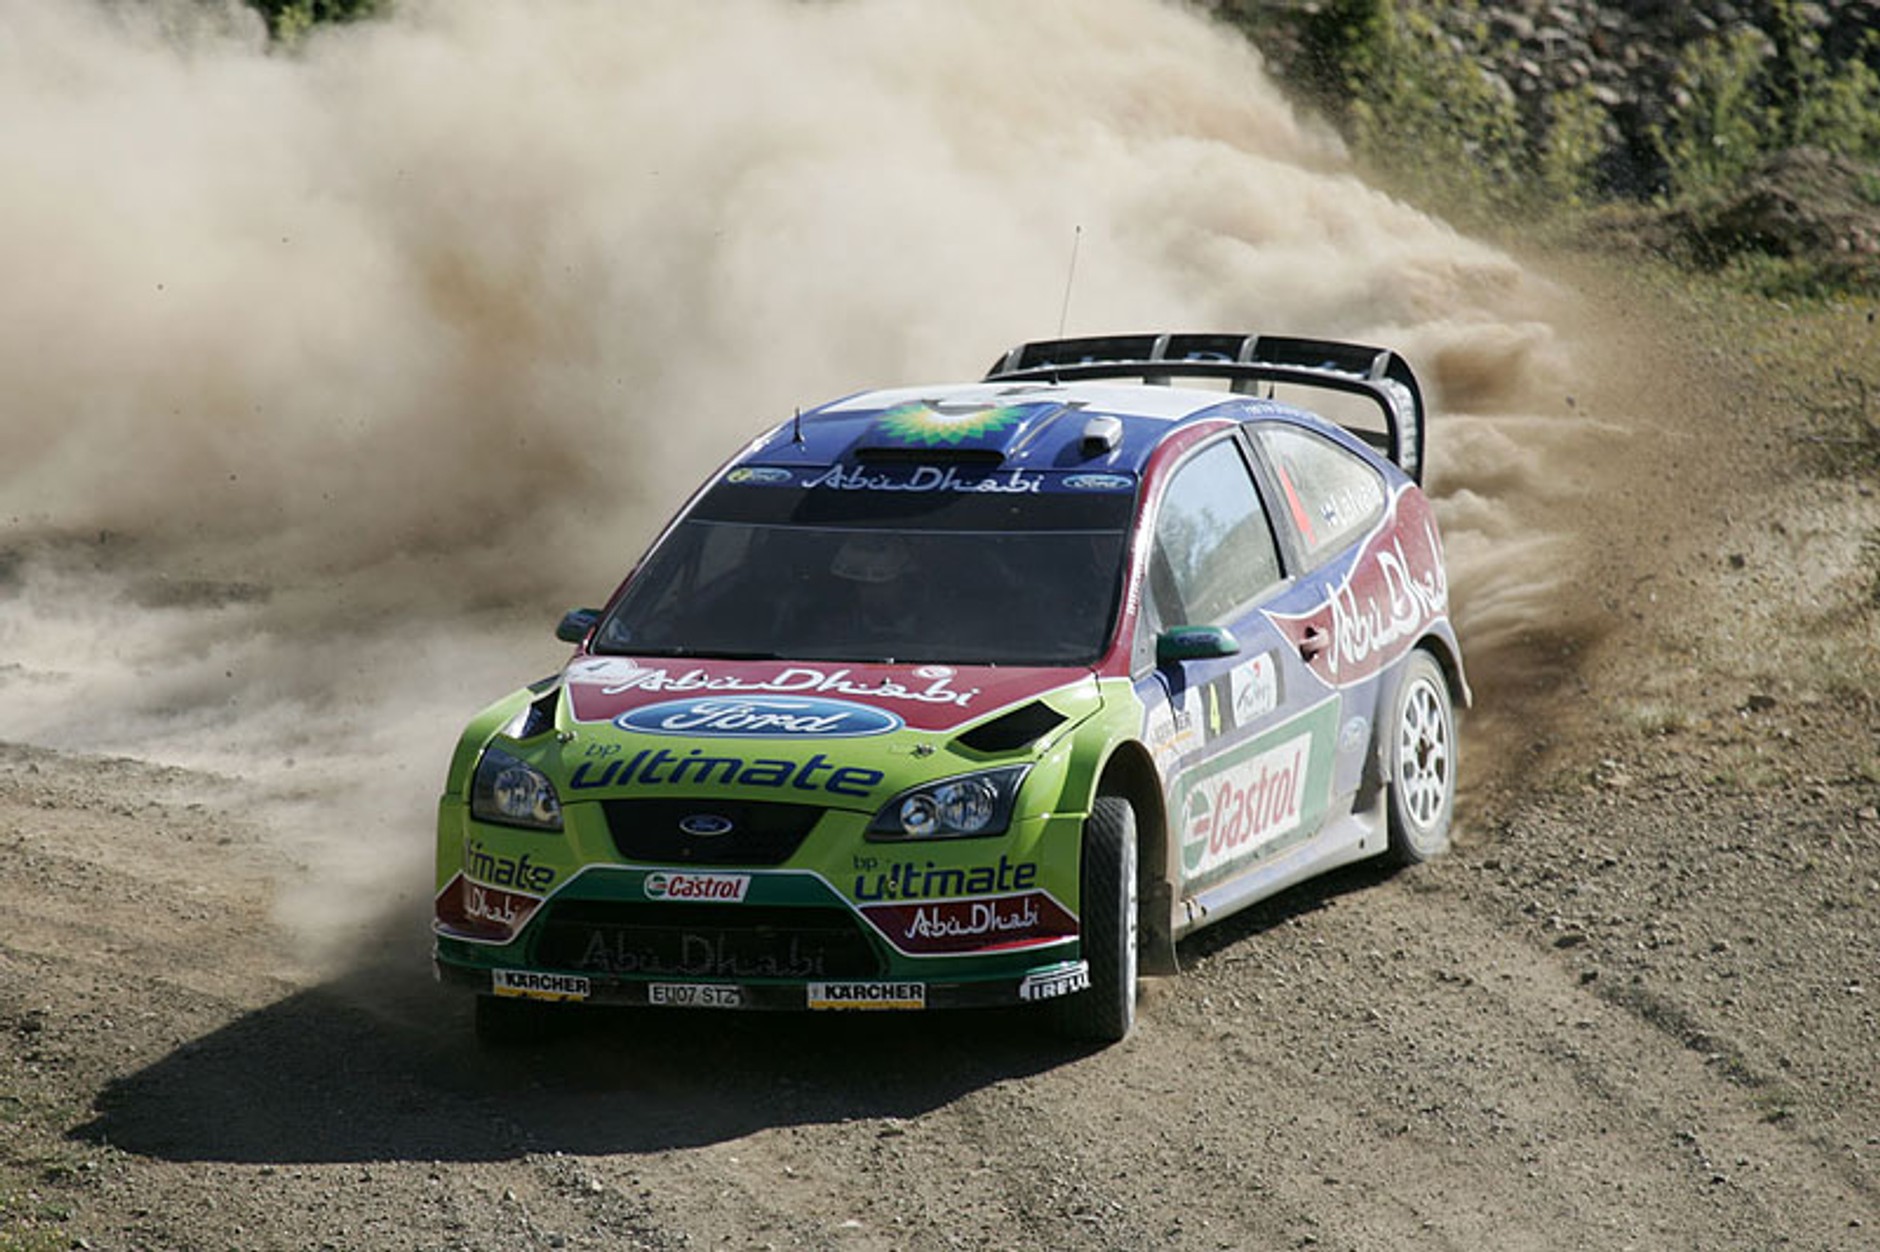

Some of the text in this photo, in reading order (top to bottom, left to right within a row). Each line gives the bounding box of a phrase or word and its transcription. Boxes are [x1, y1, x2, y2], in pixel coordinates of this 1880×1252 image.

[802, 466, 1044, 492] Abu Dhabi
[602, 668, 758, 696] Abu
[765, 668, 980, 707] Dhabi
[662, 700, 842, 733] Ford
[1210, 682, 1221, 737] 4
[585, 743, 622, 759] bp
[569, 748, 886, 797] ultimate
[1209, 750, 1302, 856] Castrol
[853, 855, 878, 871] bp
[854, 854, 1037, 900] ultimate
[667, 874, 743, 899] Castrol
[904, 898, 1040, 938] Abu Dhabi
[582, 929, 829, 977] Abu Dhabi
[653, 986, 697, 1002] EU07
